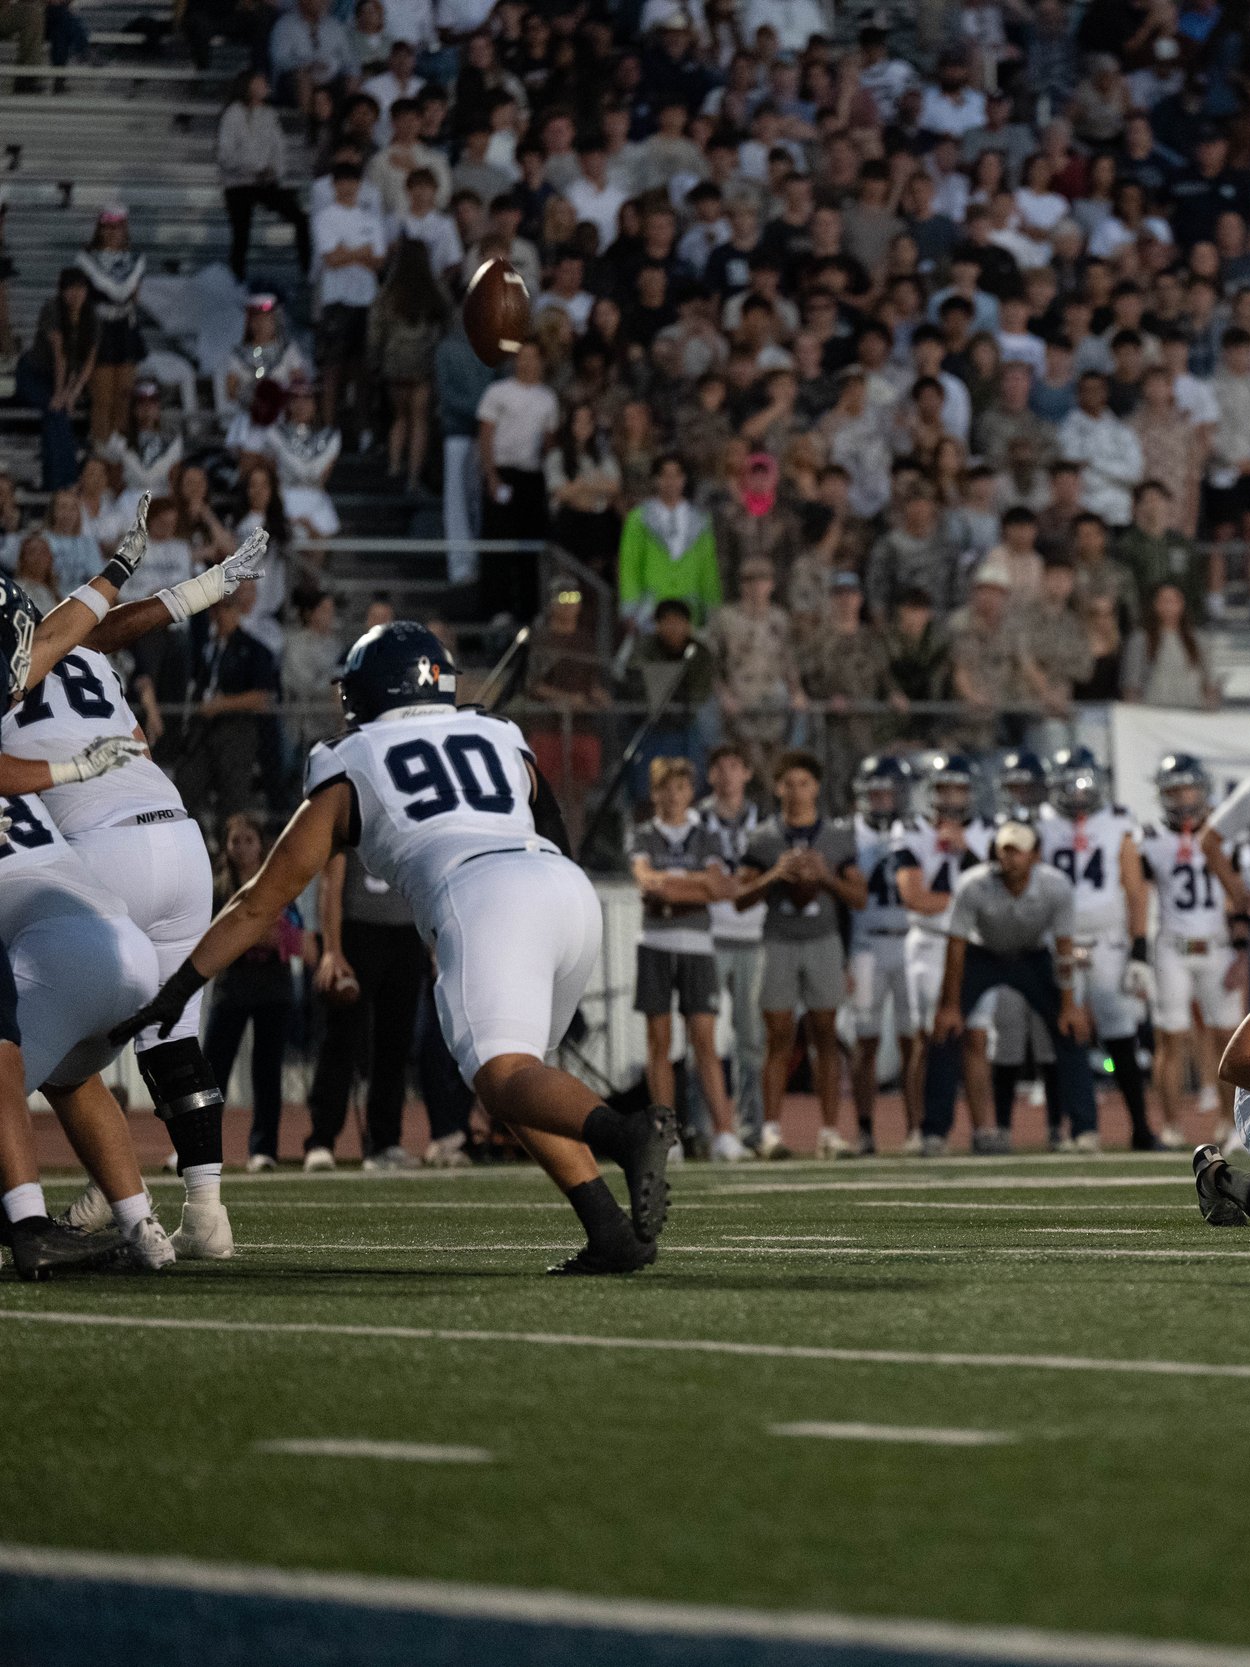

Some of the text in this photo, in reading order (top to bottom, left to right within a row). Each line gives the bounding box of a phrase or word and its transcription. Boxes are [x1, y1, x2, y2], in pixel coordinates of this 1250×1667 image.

[384, 734, 514, 822] 90
[1053, 848, 1104, 889] 94
[1173, 863, 1215, 910] 31
